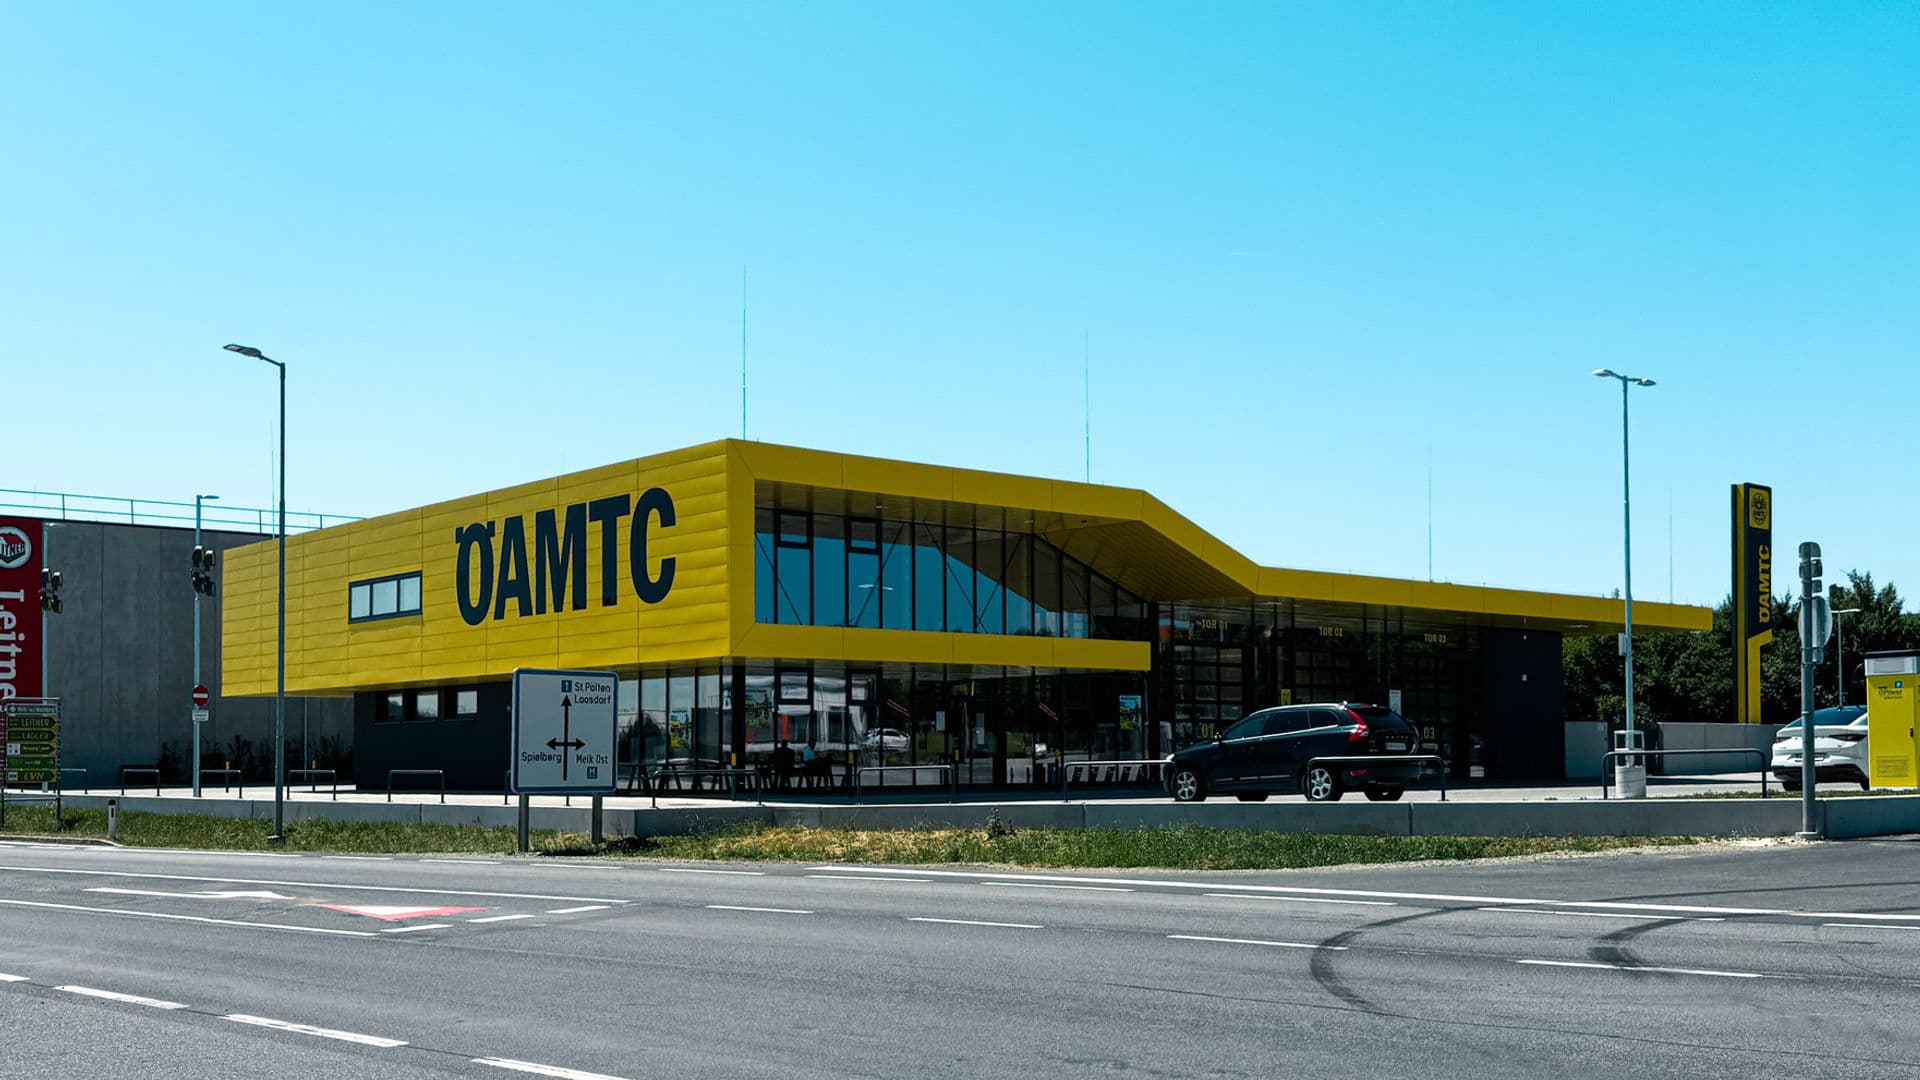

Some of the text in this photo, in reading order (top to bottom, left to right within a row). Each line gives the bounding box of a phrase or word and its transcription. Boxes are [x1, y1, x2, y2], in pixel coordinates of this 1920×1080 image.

[455, 487, 677, 626] ÖAMTC
[1201, 619, 1217, 629] TOR
[1319, 626, 1343, 637] TOR 02
[1423, 633, 1438, 642] TOR
[574, 694, 611, 704] Loosdorf
[1423, 726, 1435, 740] 03
